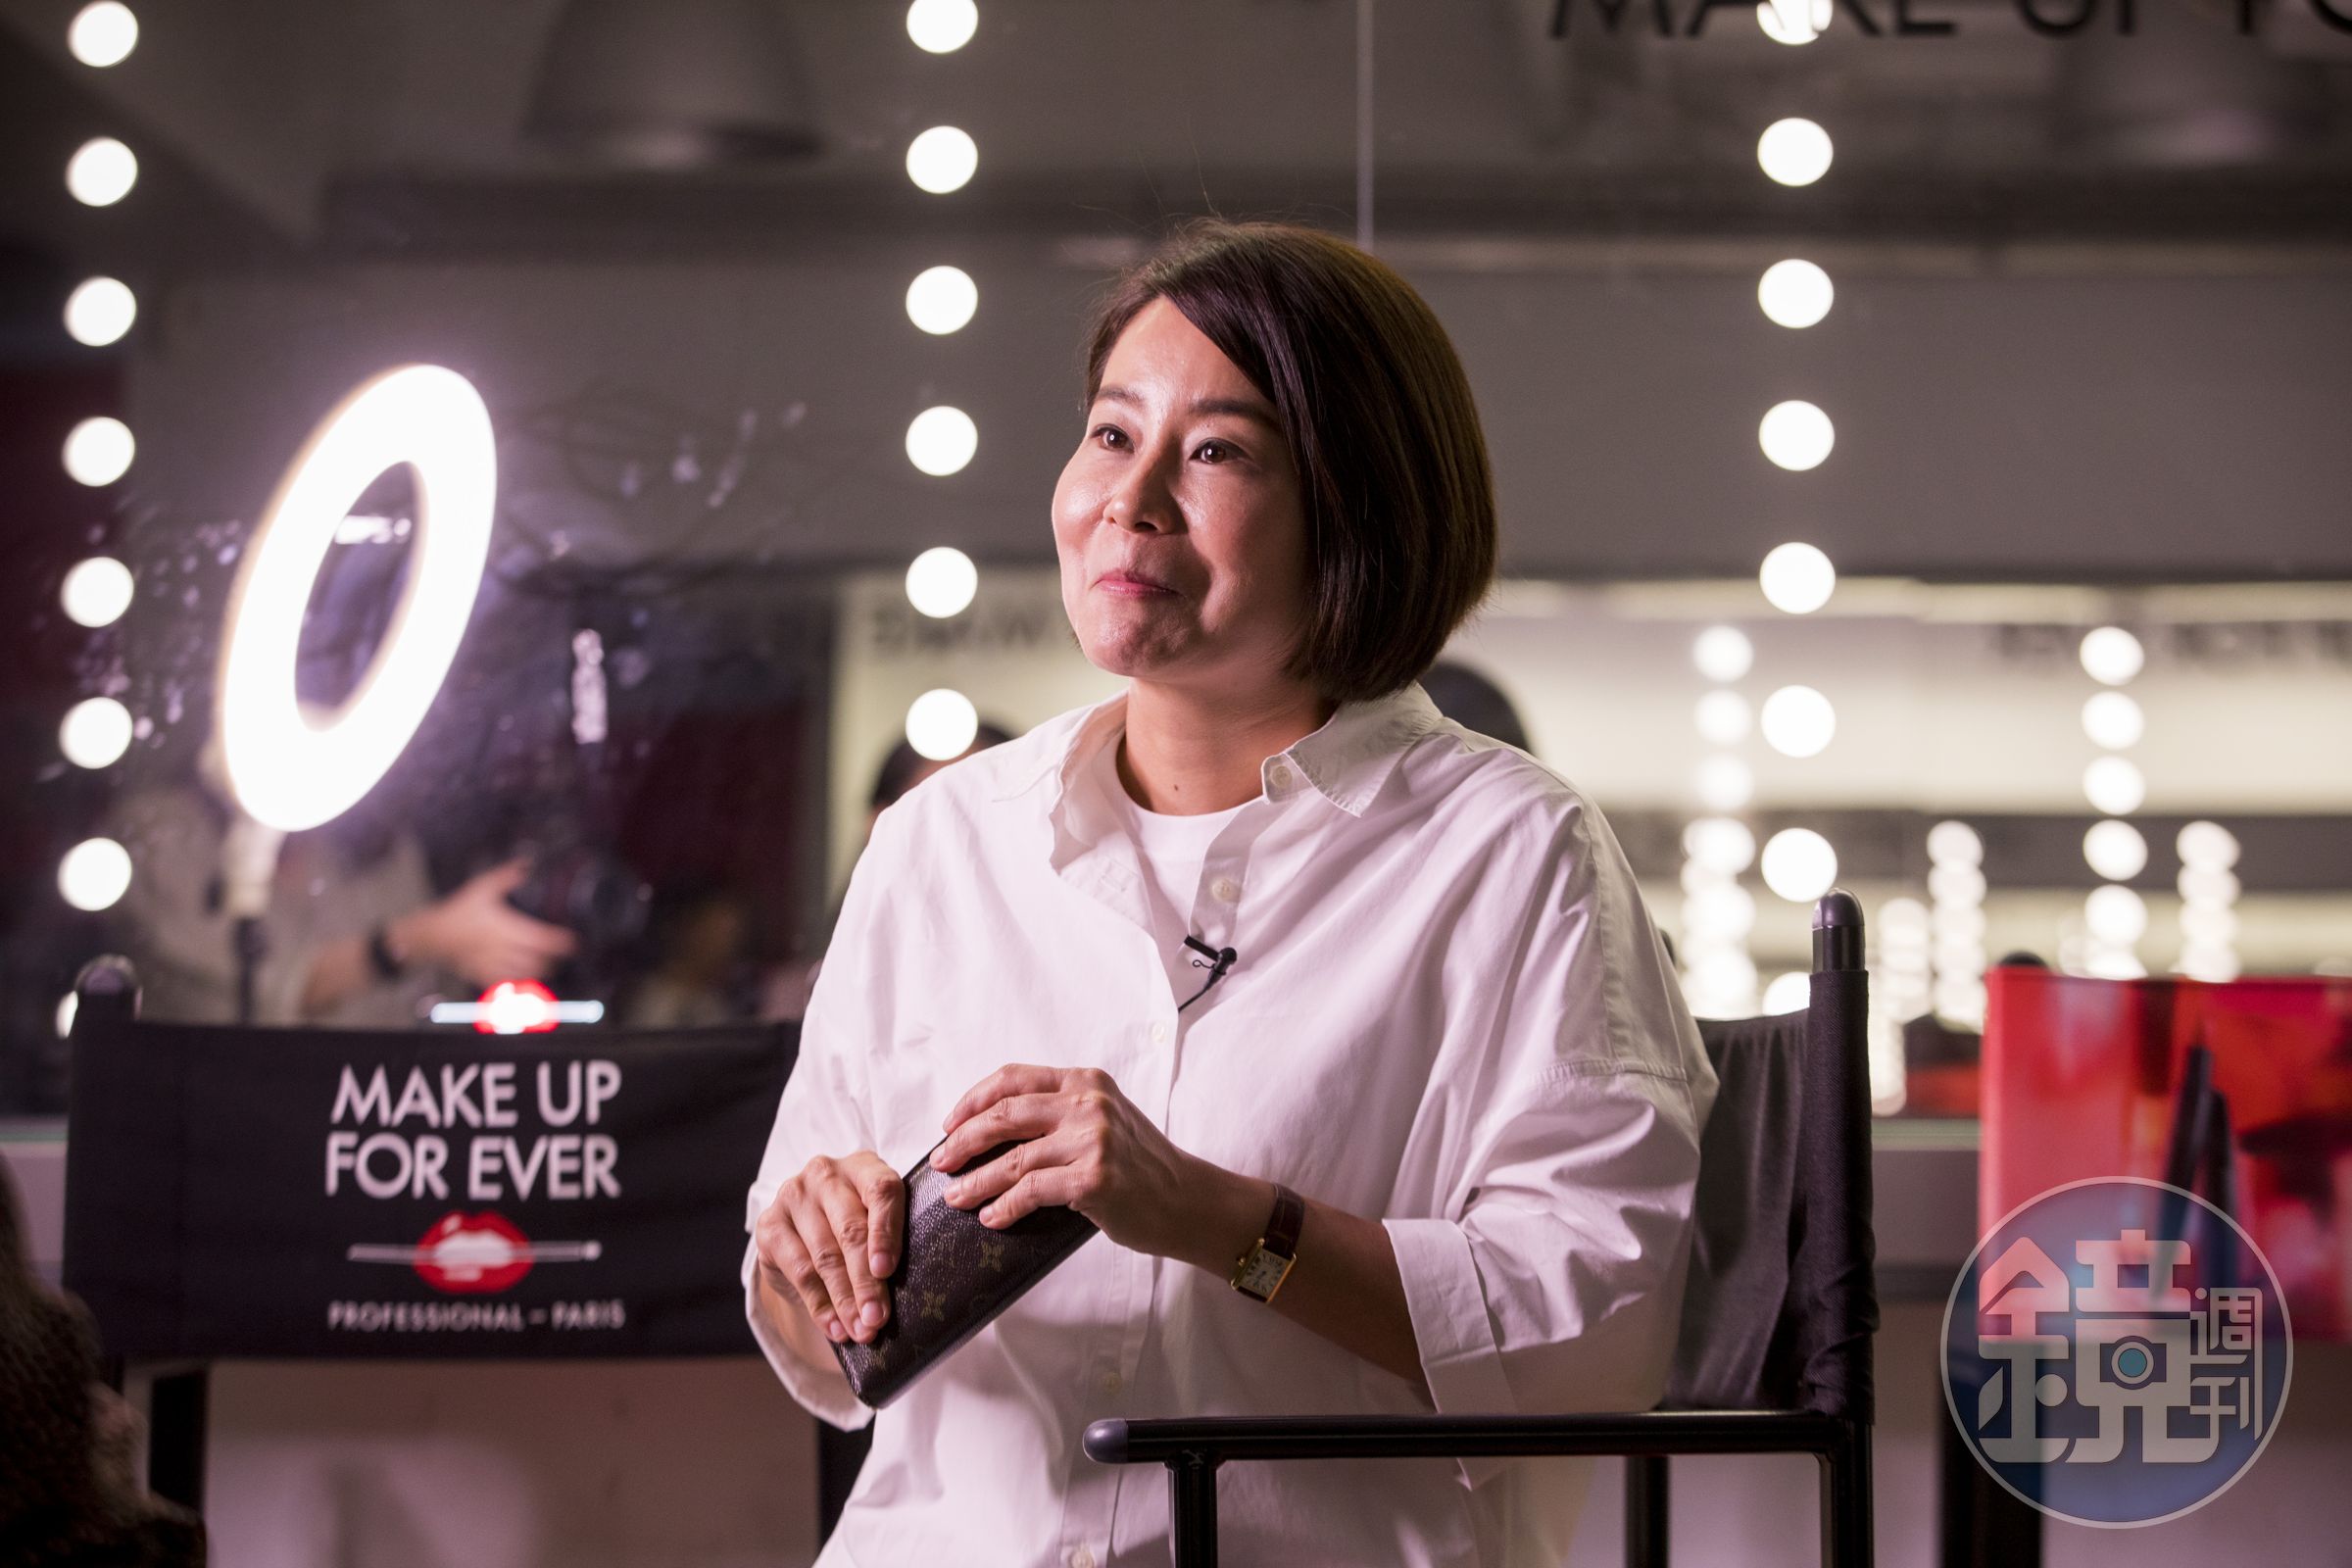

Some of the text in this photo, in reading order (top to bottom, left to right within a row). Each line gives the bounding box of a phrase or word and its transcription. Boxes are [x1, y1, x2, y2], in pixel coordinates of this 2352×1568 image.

[330, 1060, 621, 1128] MAKE UP
[325, 1132, 621, 1200] FOR EVER
[327, 1299, 523, 1332] PROFESSIONAL
[551, 1298, 625, 1330] PARIS
